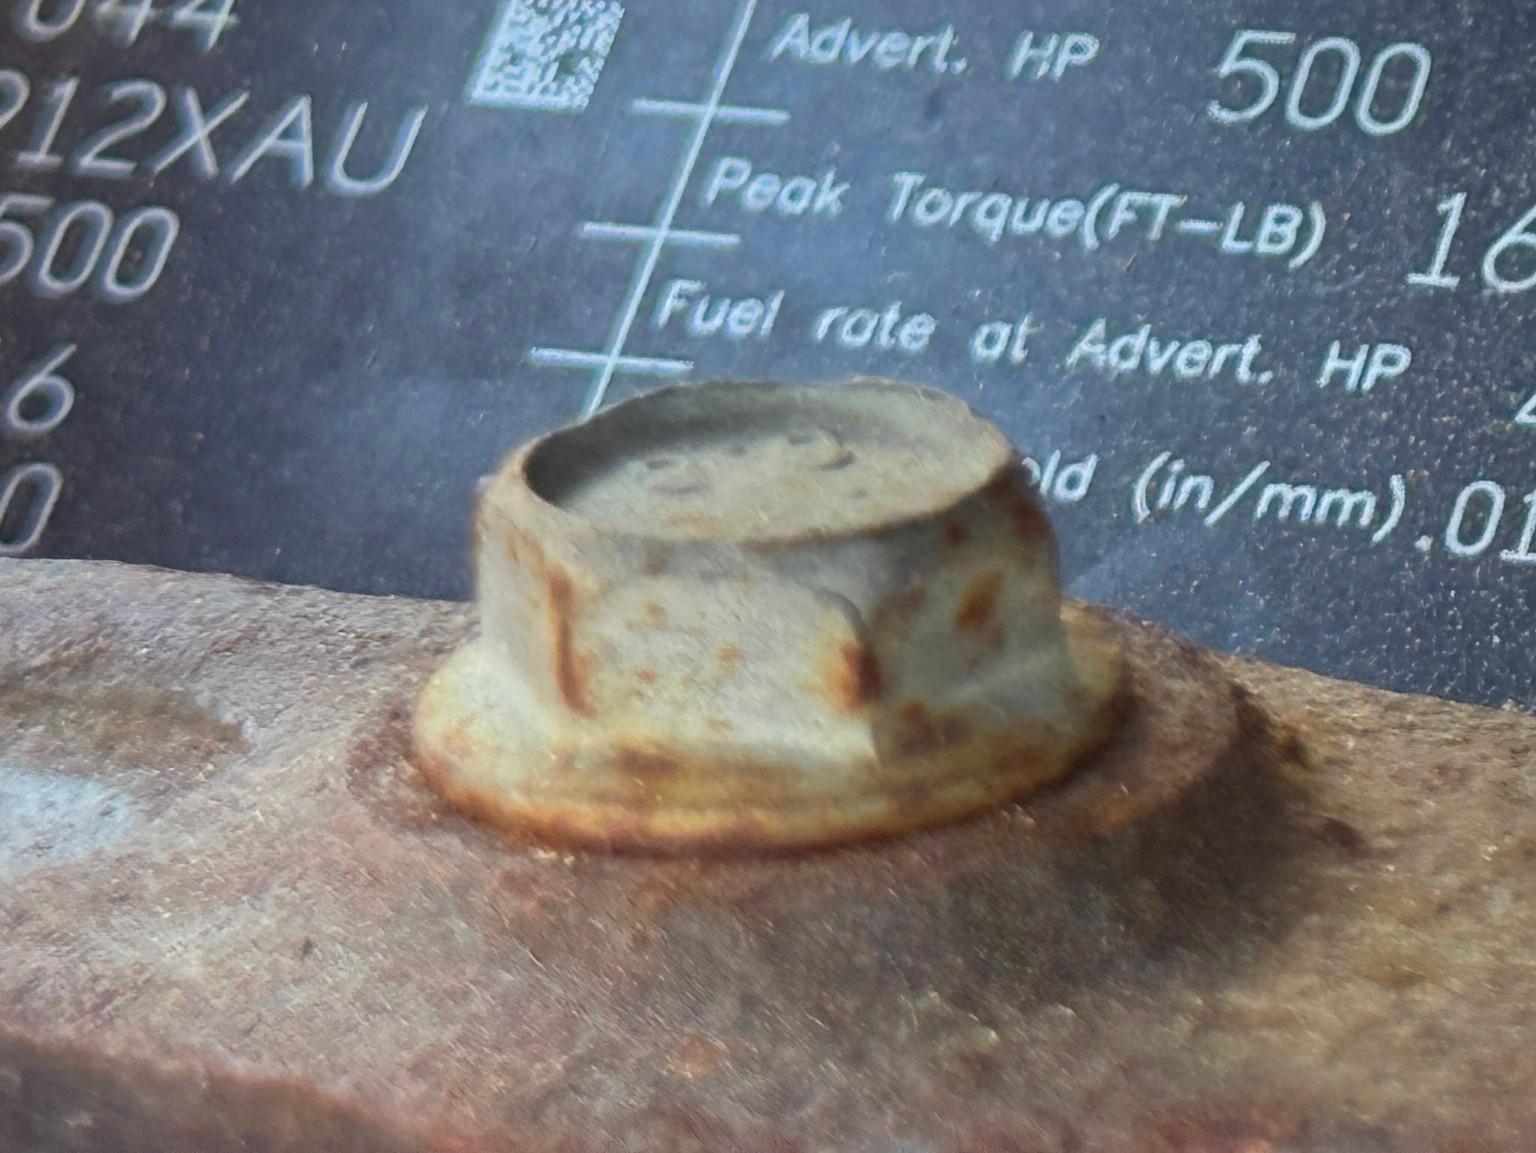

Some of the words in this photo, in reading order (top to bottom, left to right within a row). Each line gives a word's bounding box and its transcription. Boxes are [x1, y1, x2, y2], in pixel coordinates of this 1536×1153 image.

[771, 12, 968, 76] Advert.
[1009, 31, 1101, 80] HP
[1207, 28, 1432, 137] 500
[0, 193, 180, 299] 500
[706, 156, 851, 218] Peak
[891, 170, 1326, 270] Torque(FT-LB)
[653, 279, 786, 336] Fuel
[812, 300, 937, 351] rate
[970, 314, 1036, 363] at
[1066, 319, 1272, 385] Advert.
[1318, 341, 1411, 394] HP
[1132, 450, 1407, 543] (in/mm)
